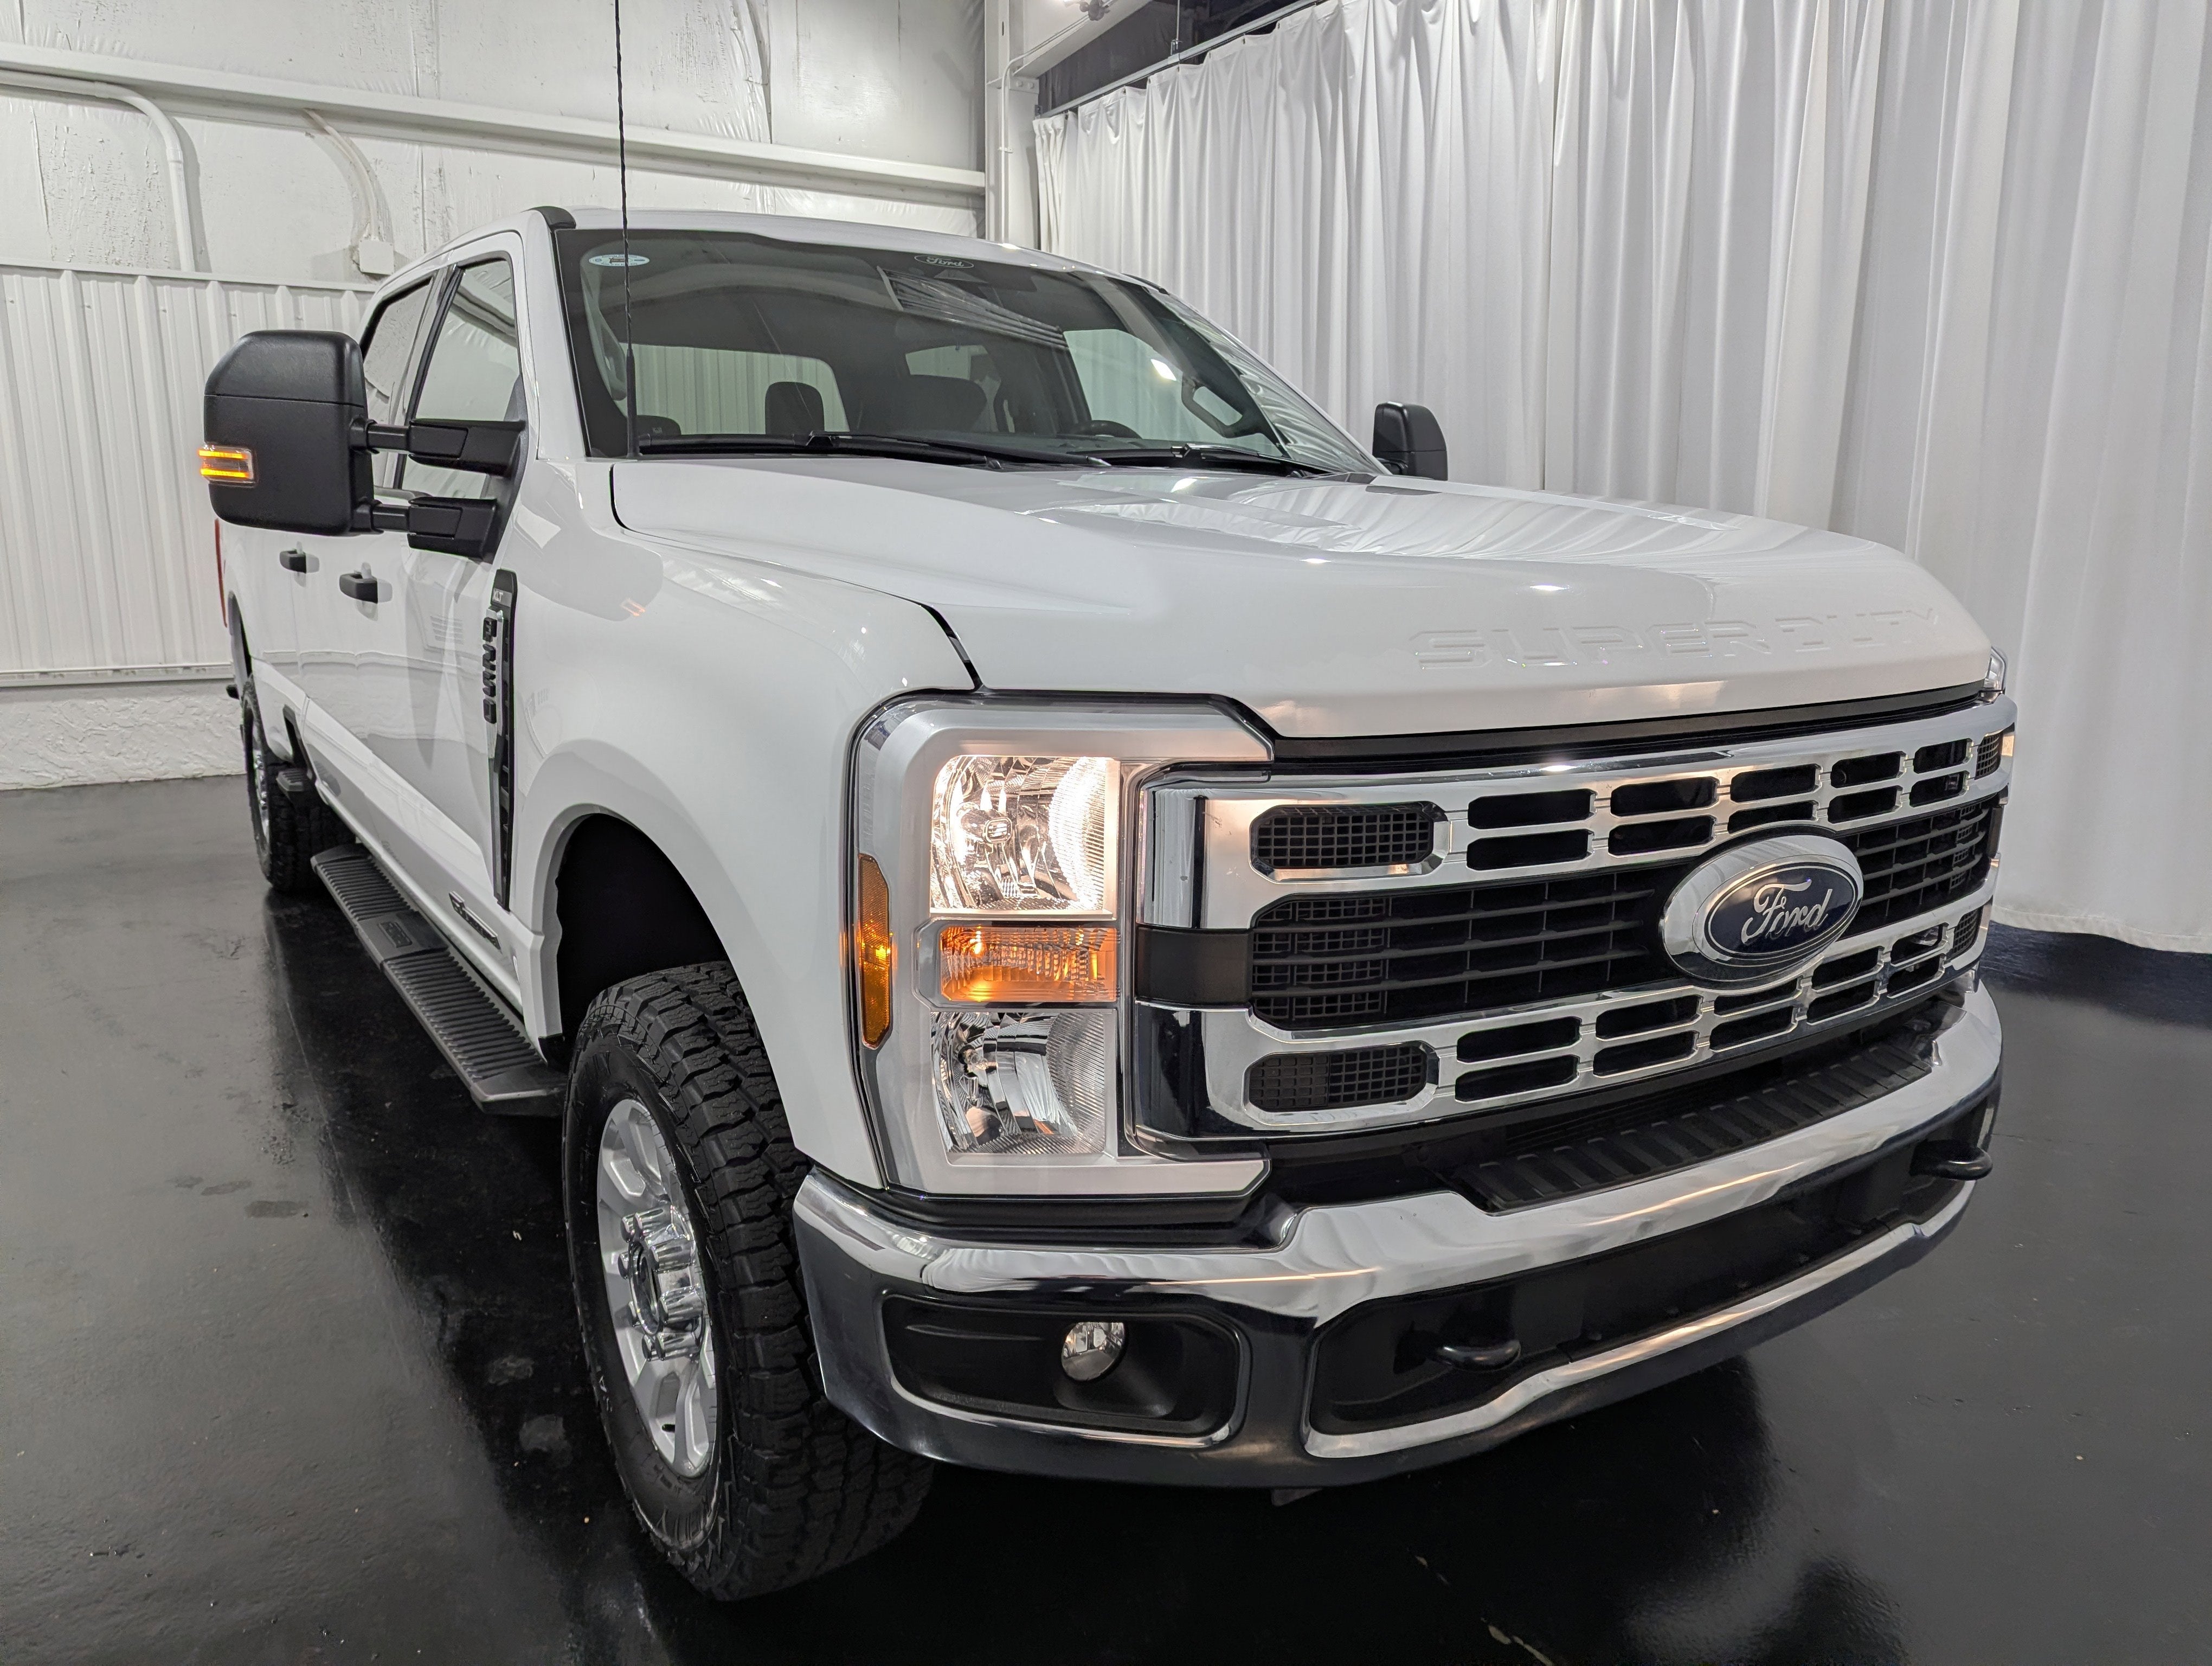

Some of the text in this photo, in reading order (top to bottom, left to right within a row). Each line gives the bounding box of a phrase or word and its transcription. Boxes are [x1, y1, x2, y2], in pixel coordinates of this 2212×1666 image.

[926, 256, 964, 267] Ford
[1409, 620, 1772, 670] SUPER
[1741, 879, 1833, 944] Ford
